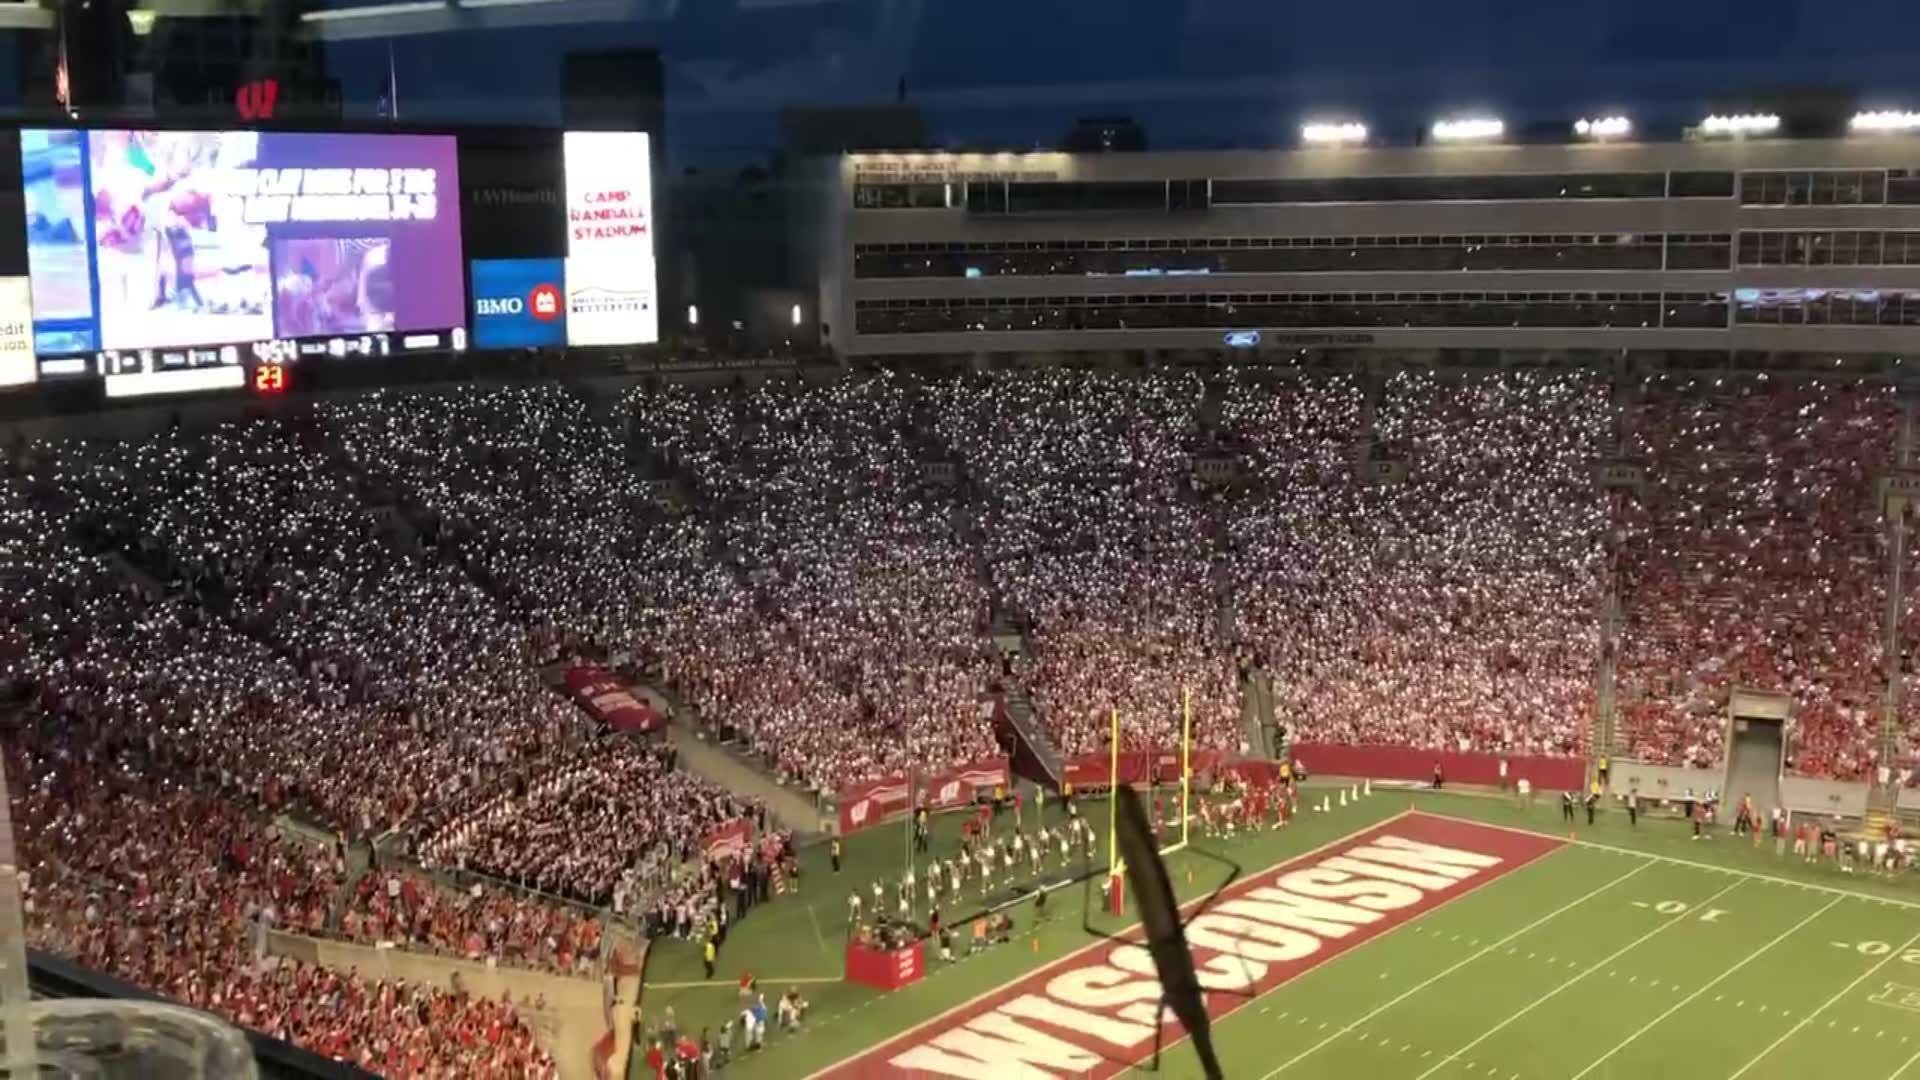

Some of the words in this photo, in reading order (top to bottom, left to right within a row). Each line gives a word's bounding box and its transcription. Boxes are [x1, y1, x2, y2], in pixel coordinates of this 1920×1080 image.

[584, 190, 631, 204] CAMP
[570, 207, 646, 222] RANDALL
[574, 224, 647, 240] STADIUM
[476, 297, 523, 315] BMO
[256, 366, 283, 390] 23
[888, 833, 1505, 1080] WISCONSIN
